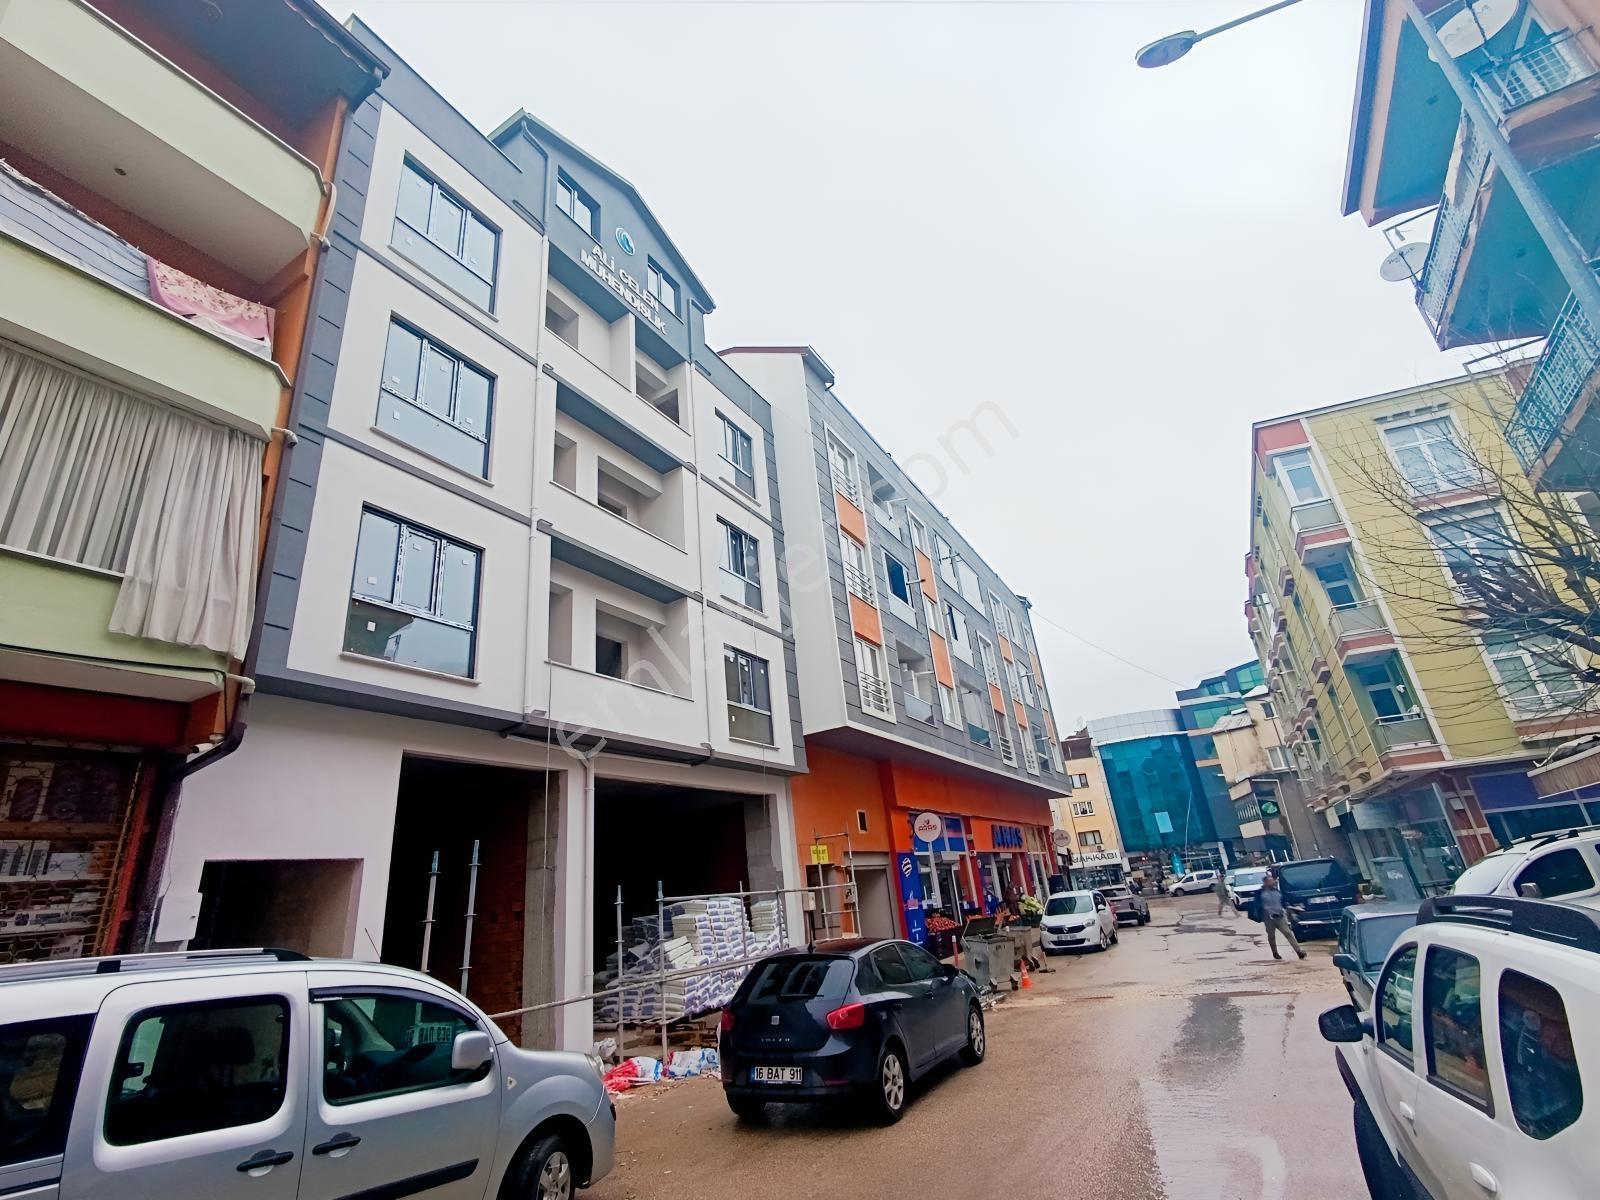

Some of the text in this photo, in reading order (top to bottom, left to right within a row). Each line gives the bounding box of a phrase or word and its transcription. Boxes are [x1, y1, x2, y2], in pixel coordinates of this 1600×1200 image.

[756, 1067, 802, 1081] 16 BAT 911
